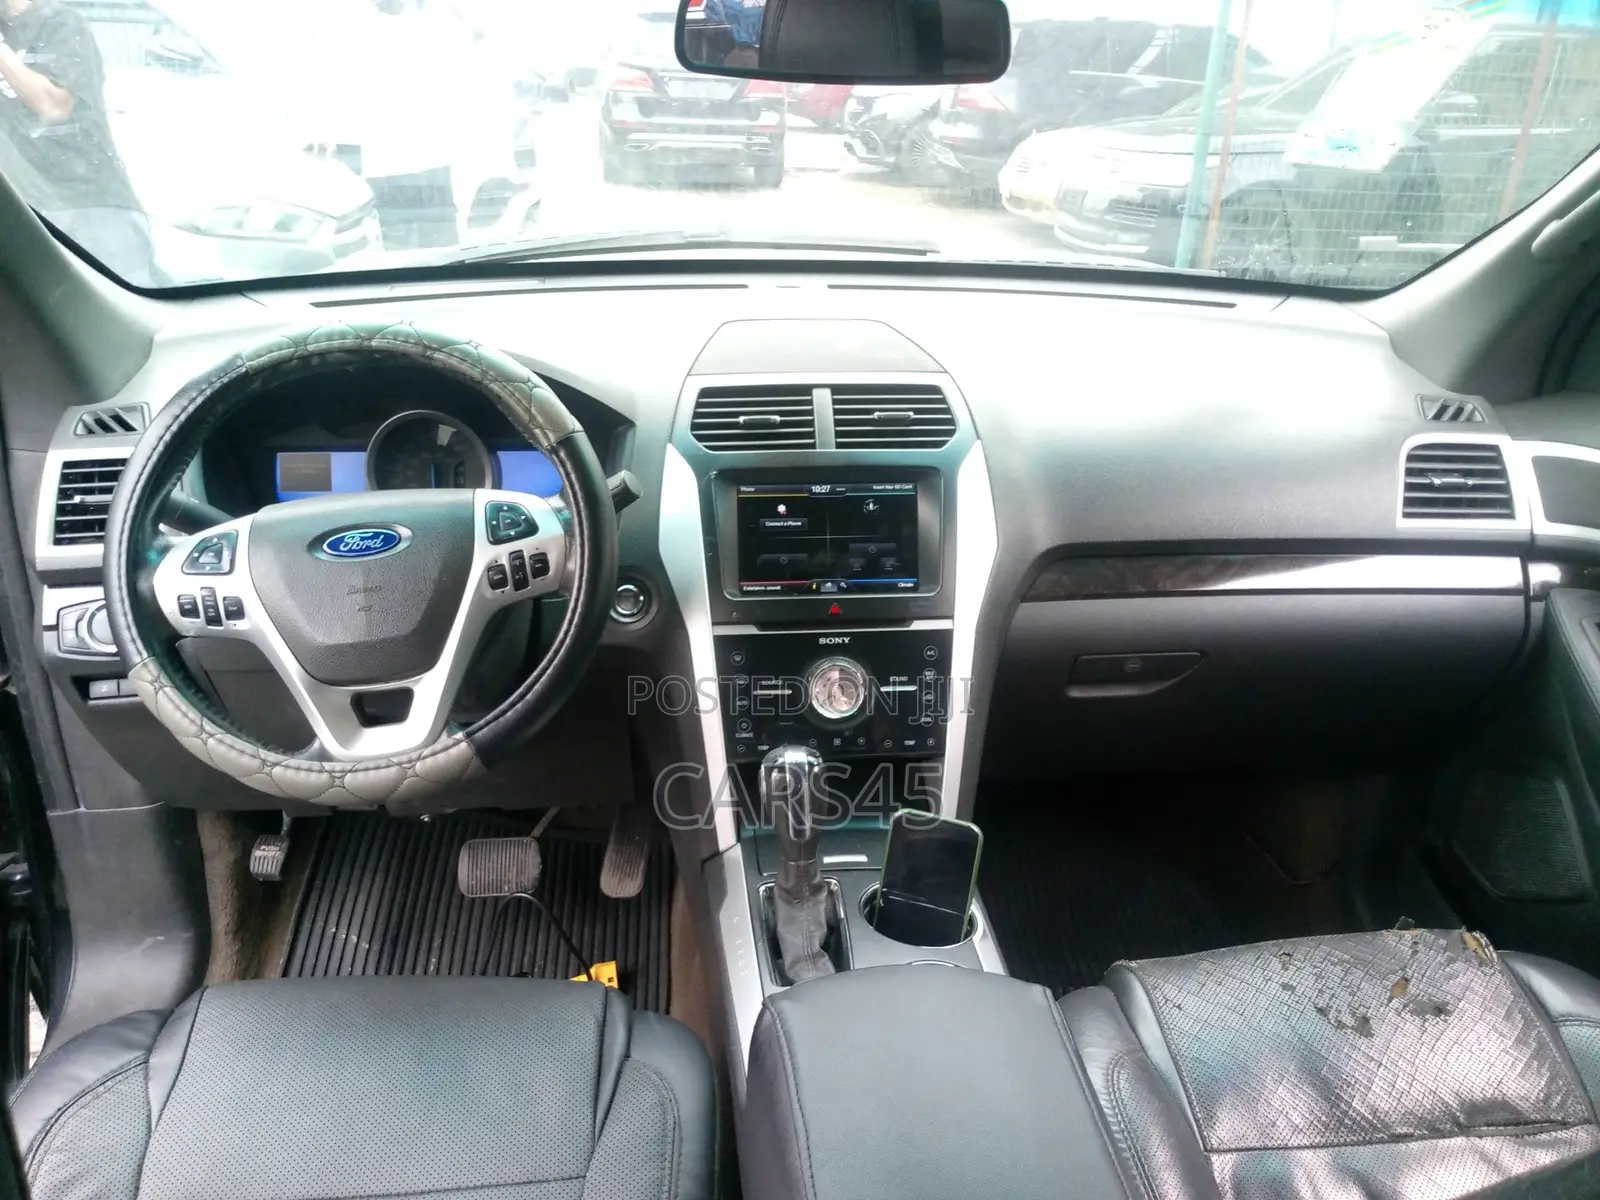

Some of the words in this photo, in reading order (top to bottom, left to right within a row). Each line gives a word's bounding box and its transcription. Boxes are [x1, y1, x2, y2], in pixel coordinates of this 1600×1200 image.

[811, 485, 831, 493] 10:27
[339, 532, 384, 551] Ford
[818, 637, 851, 645] SONY
